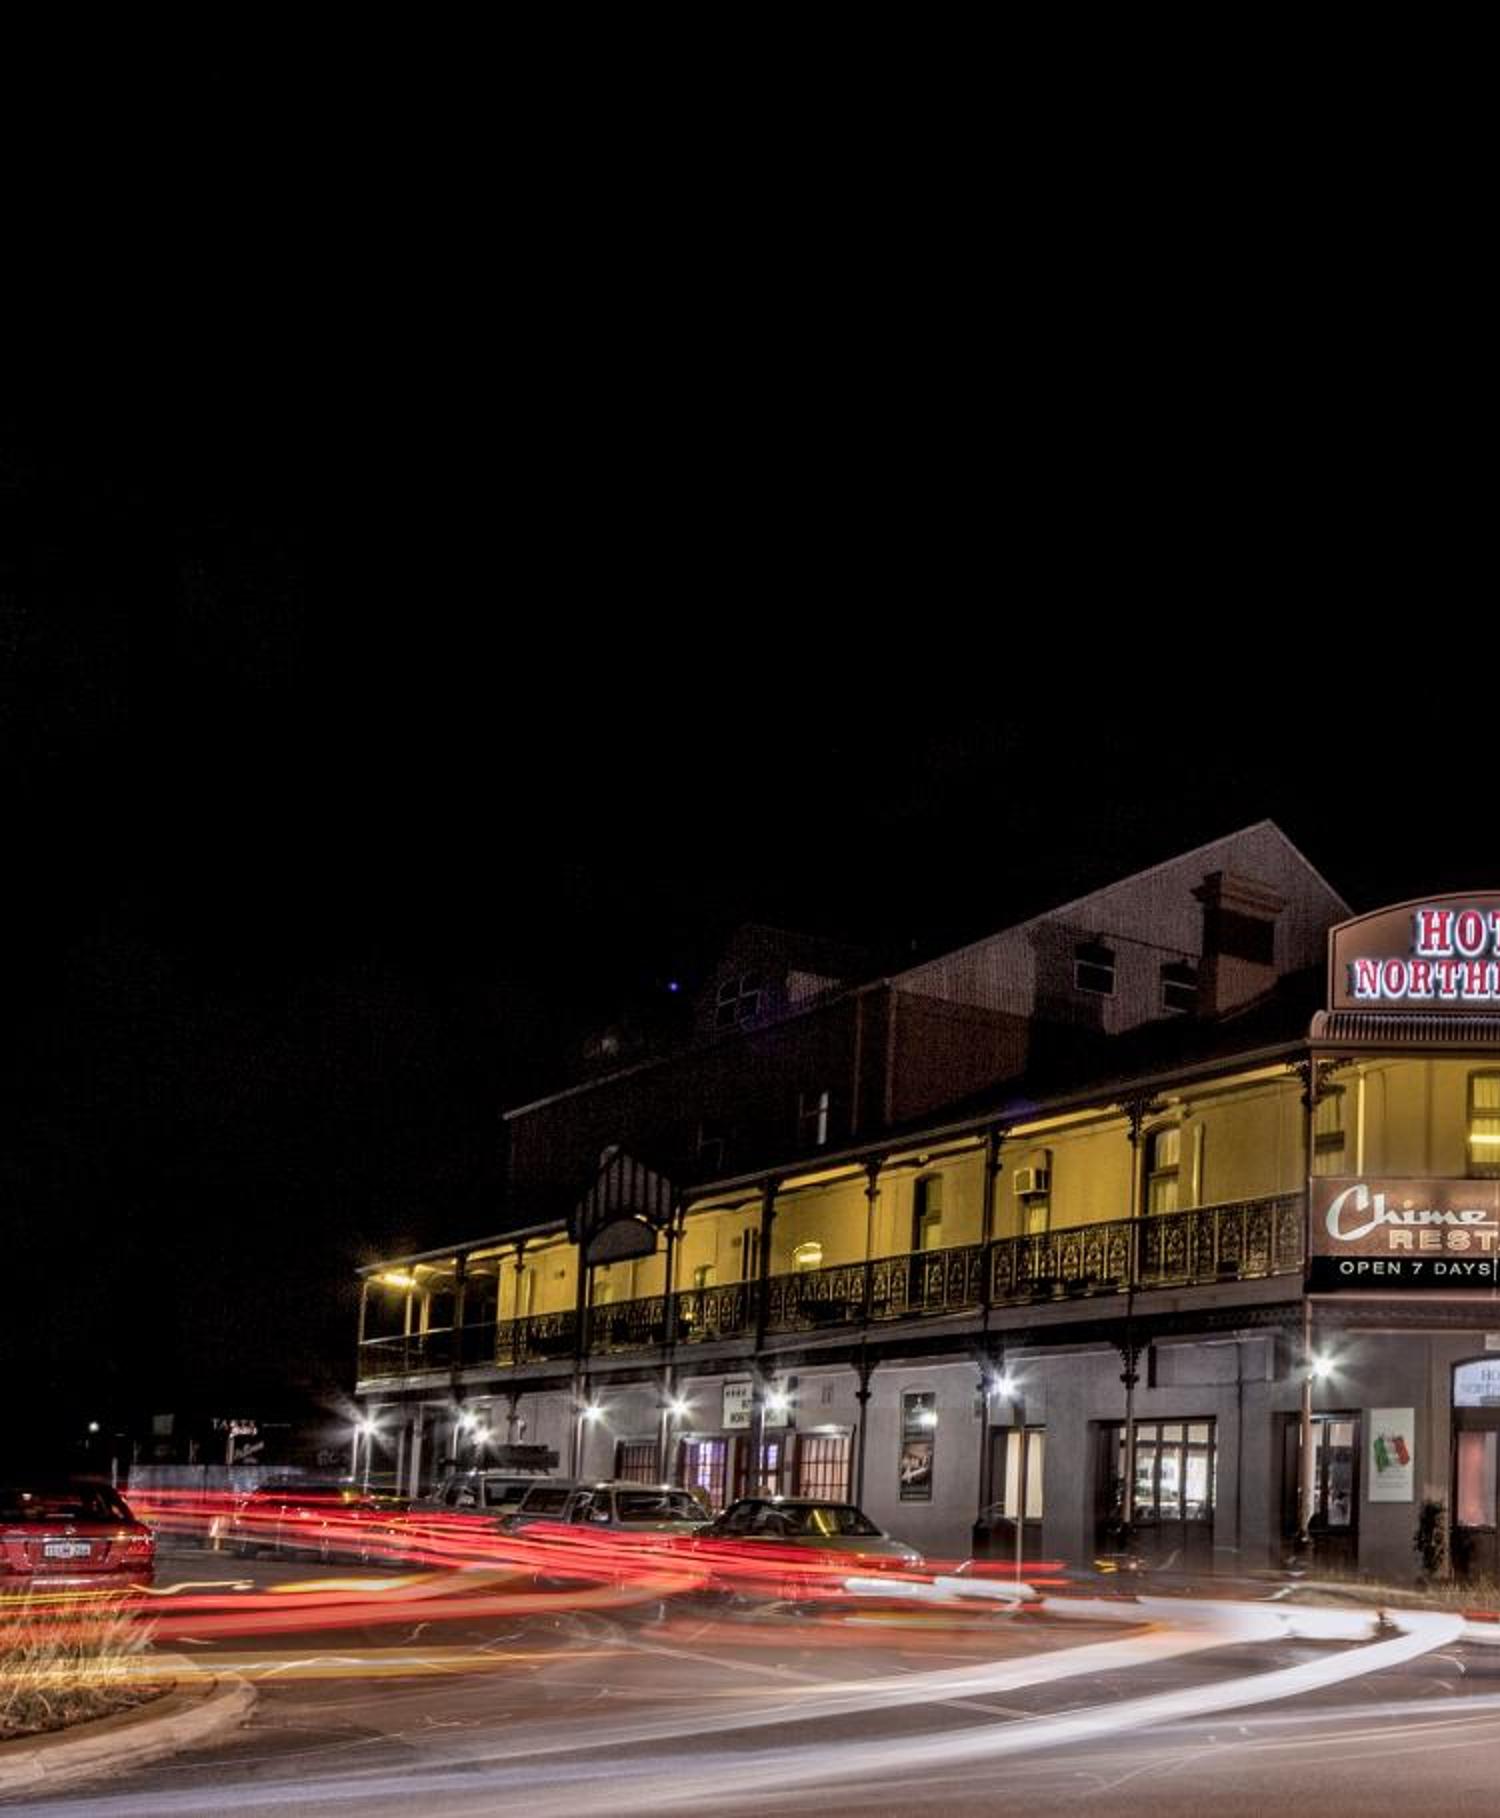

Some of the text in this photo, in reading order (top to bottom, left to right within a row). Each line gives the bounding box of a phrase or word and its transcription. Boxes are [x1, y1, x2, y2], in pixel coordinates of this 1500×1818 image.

[1326, 1183, 1499, 1241] Chime
[1339, 1261, 1401, 1275] OPEN
[1411, 1262, 1423, 1275] 7
[1434, 1262, 1491, 1276] DAYS
